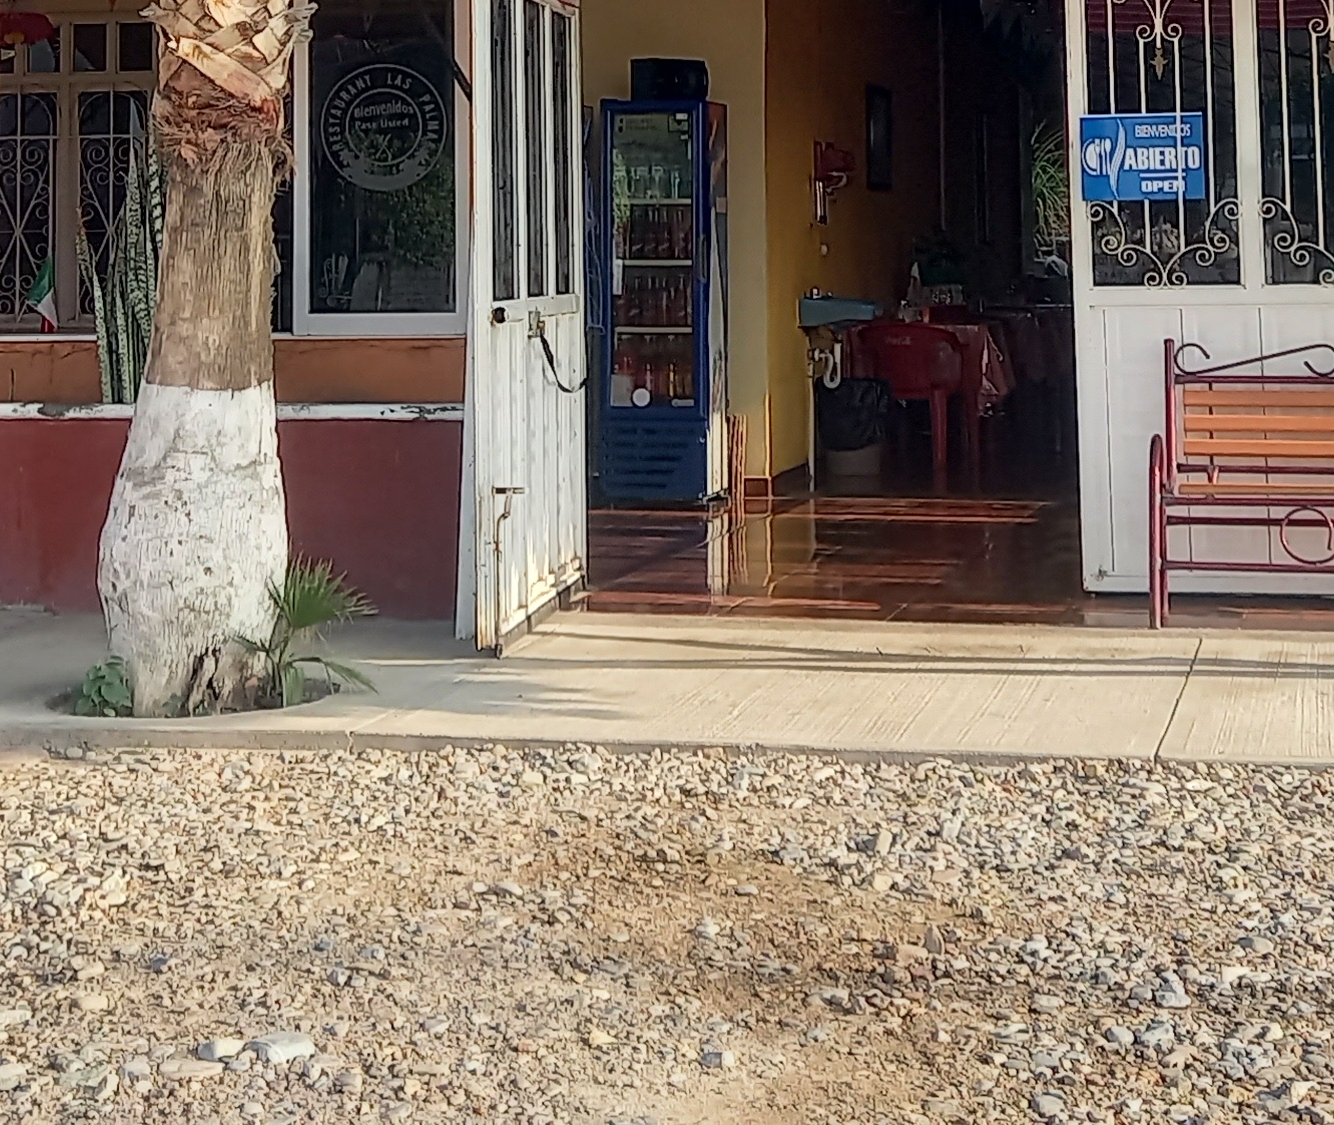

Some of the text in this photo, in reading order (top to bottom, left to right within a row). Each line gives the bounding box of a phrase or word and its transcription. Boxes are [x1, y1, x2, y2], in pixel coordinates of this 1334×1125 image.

[387, 72, 412, 89] LAS
[1123, 146, 1201, 170] ABIERTO
[1141, 180, 1186, 192] OPEN
